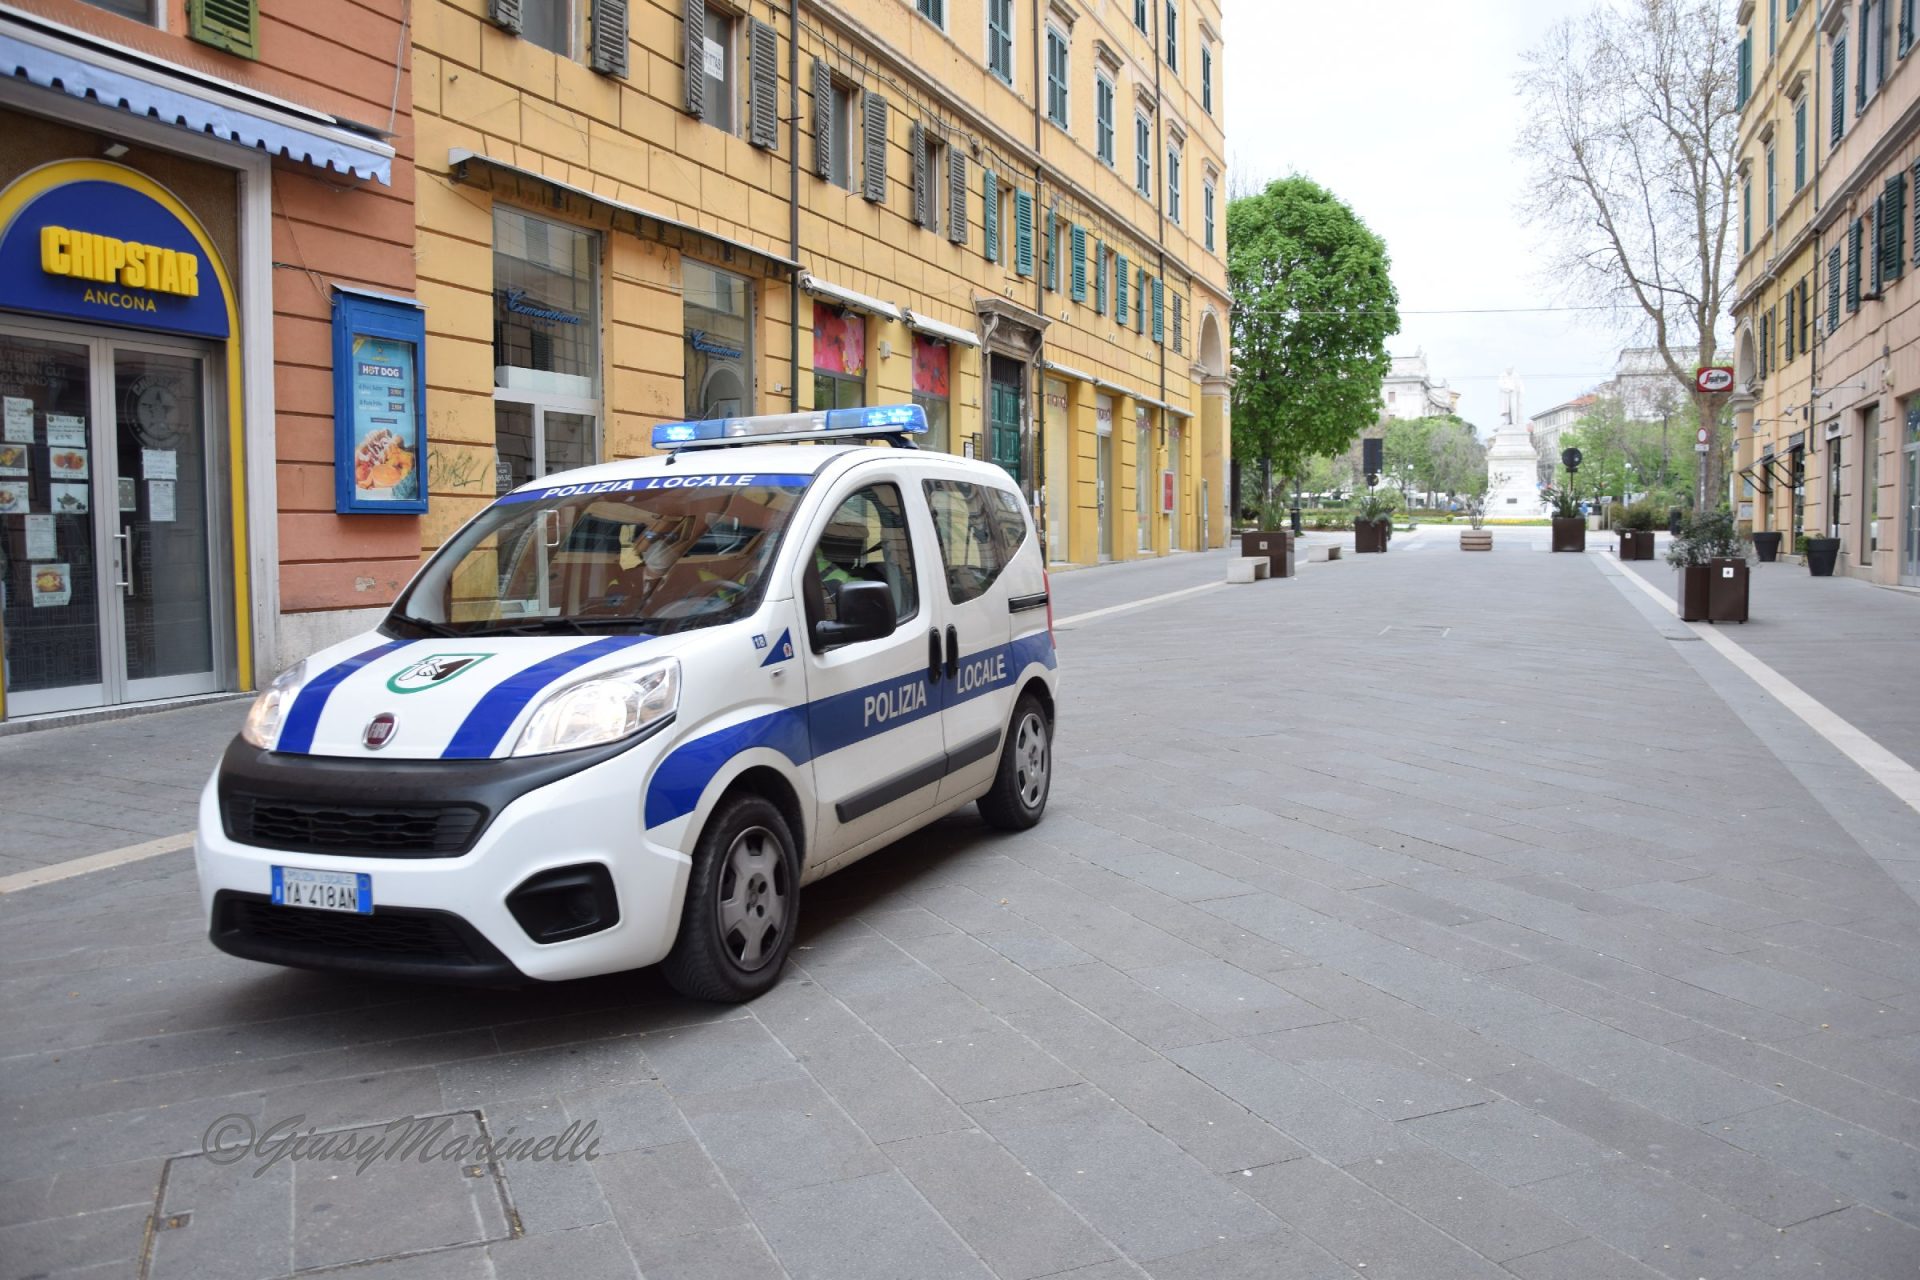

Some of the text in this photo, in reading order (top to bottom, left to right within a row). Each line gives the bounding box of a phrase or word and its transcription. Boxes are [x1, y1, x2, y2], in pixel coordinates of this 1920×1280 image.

[40, 225, 199, 297] CHIPSTAR
[84, 289, 157, 312] ANCONA
[362, 365, 400, 377] HOT DOG
[541, 474, 756, 499] POLIZIA LOCALE
[864, 653, 1007, 727] POLIZIA LOCALE
